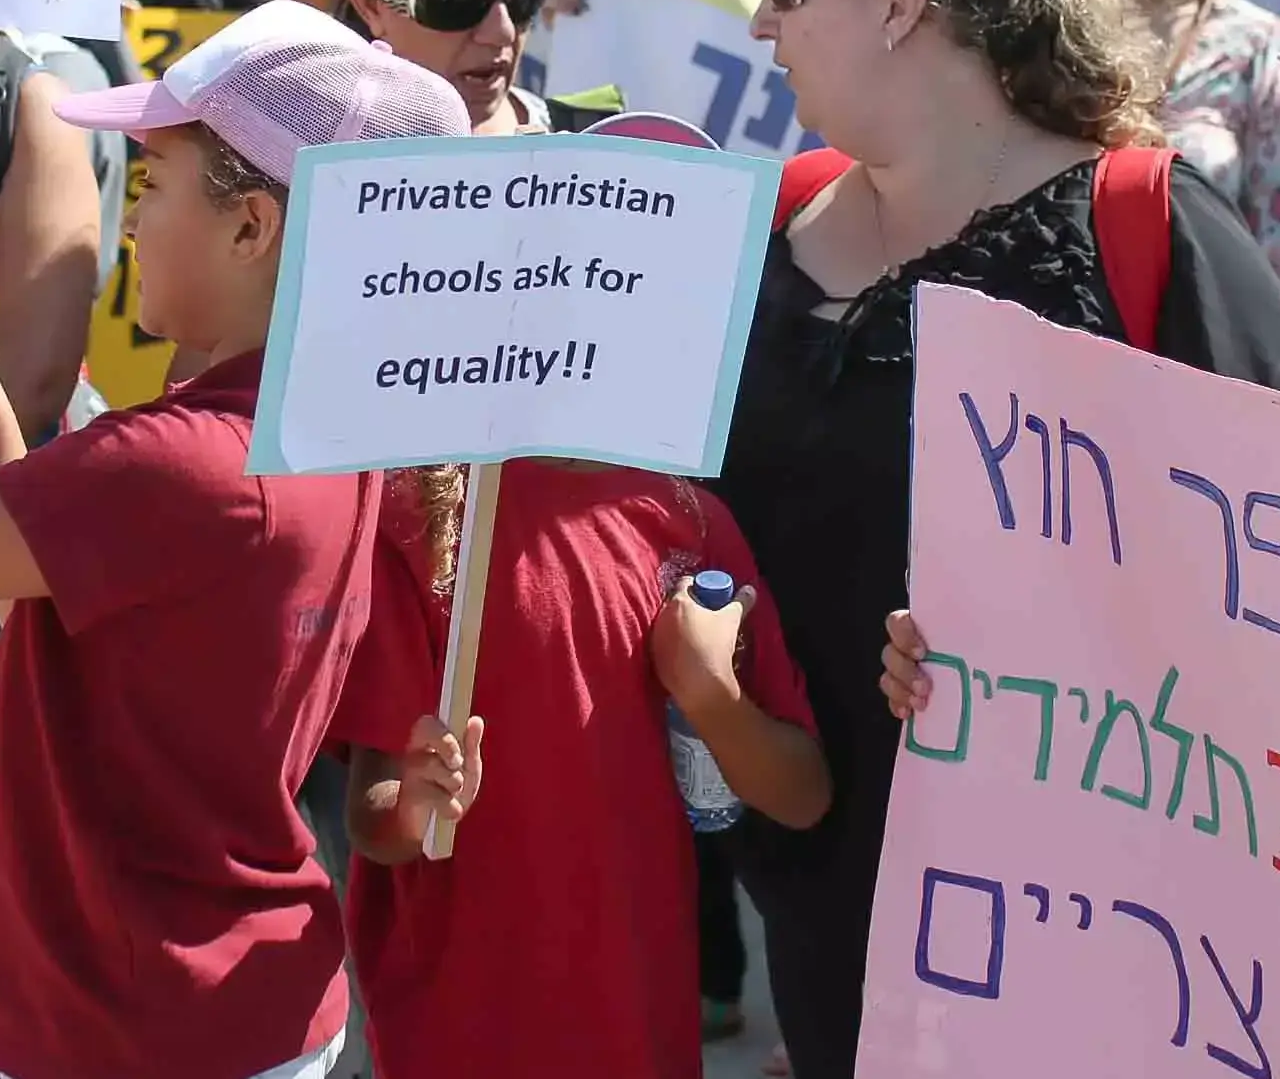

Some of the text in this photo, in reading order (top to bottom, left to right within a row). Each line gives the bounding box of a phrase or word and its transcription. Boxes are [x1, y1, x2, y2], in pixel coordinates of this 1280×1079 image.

[357, 173, 676, 218] Private Christian
[361, 255, 644, 299] schools ask for
[375, 340, 598, 395] equality!!
[957, 391, 1122, 566] חוץ
